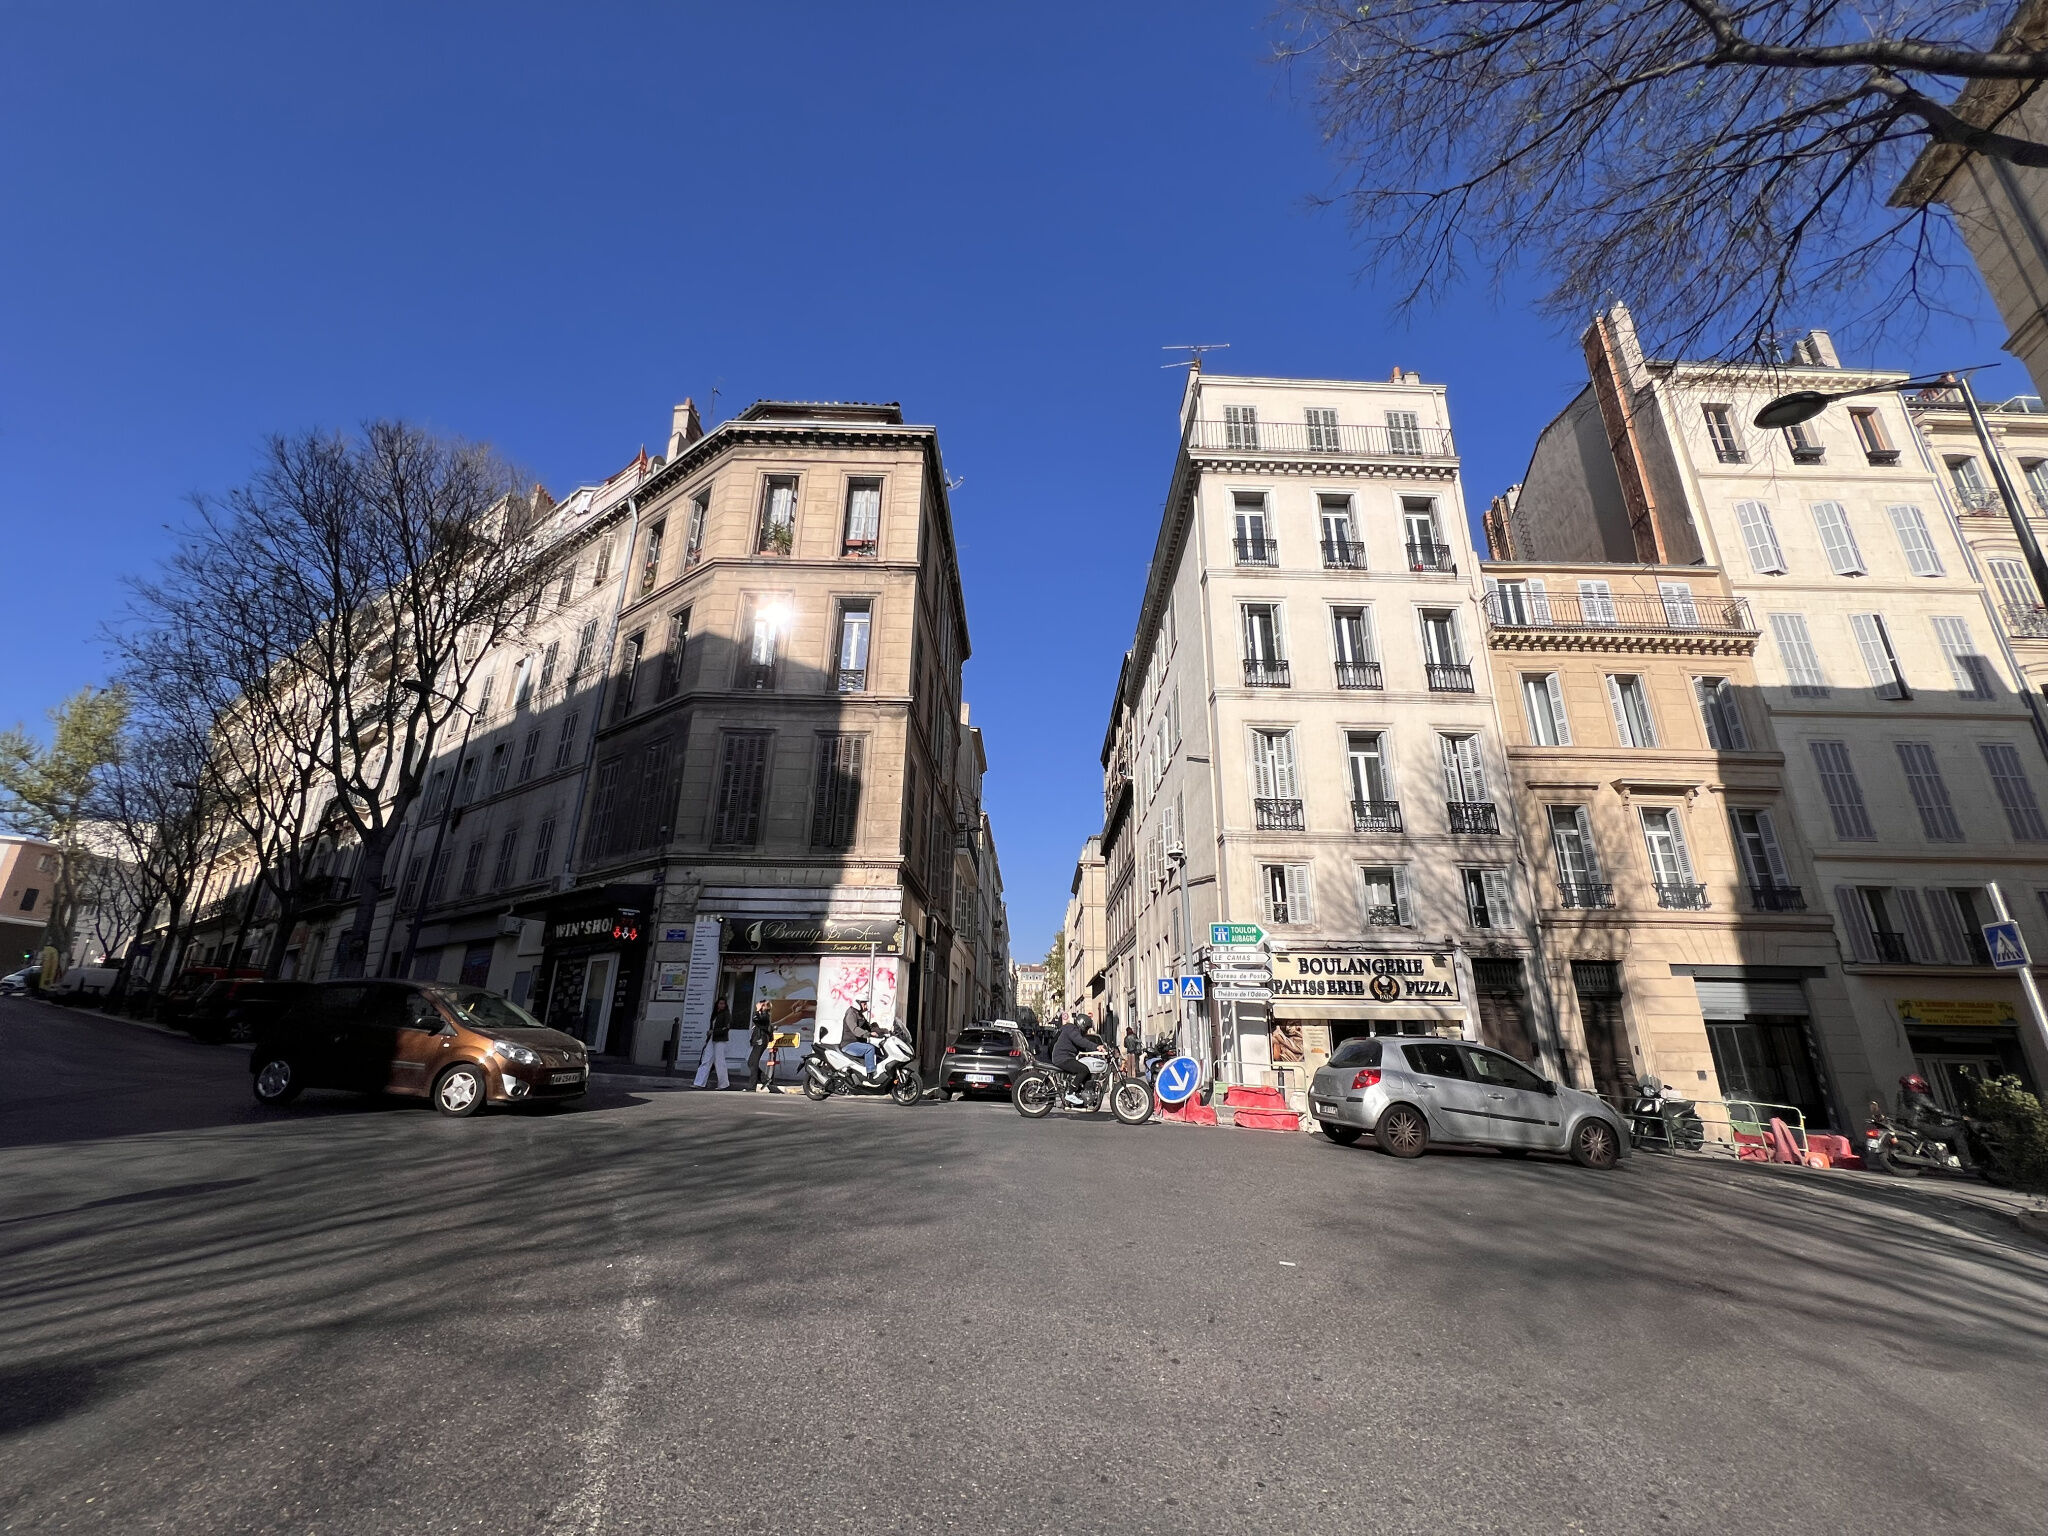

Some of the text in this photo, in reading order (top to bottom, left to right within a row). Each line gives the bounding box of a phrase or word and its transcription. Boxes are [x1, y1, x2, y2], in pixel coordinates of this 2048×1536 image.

[763, 920, 821, 946] Beauty
[1230, 926, 1257, 934] TOULON
[1297, 957, 1425, 976] BOULANGERIE
[1247, 990, 1269, 998] l'Odéon
[1272, 979, 1454, 997] PATISSERIE PIZZA
